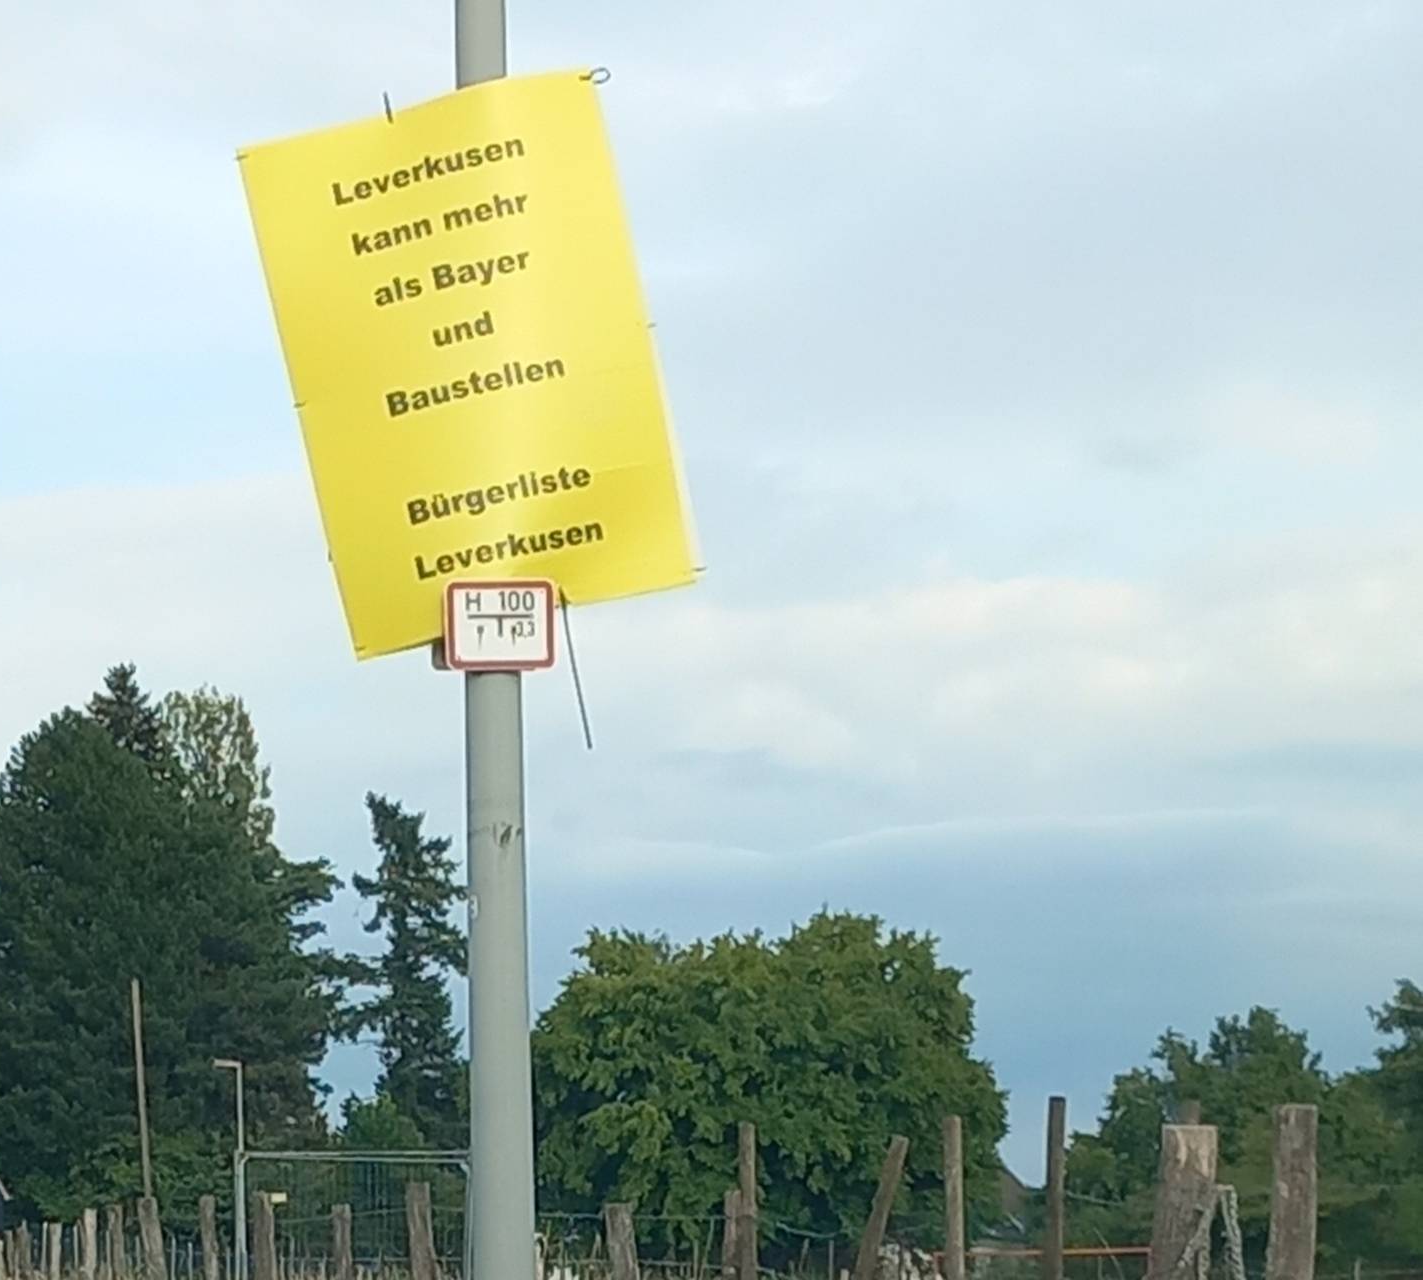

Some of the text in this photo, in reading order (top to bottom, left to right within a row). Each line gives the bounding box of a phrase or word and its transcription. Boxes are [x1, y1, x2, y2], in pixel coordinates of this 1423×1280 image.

[332, 137, 526, 206] Leverkusen
[351, 192, 529, 257] kann mehr
[373, 249, 531, 307] als Bayer
[432, 311, 495, 348] und
[386, 356, 566, 418] Baustellen
[407, 467, 591, 525] Bürgerliste
[414, 521, 604, 580] Leverkusen
[466, 591, 535, 611] H 100
